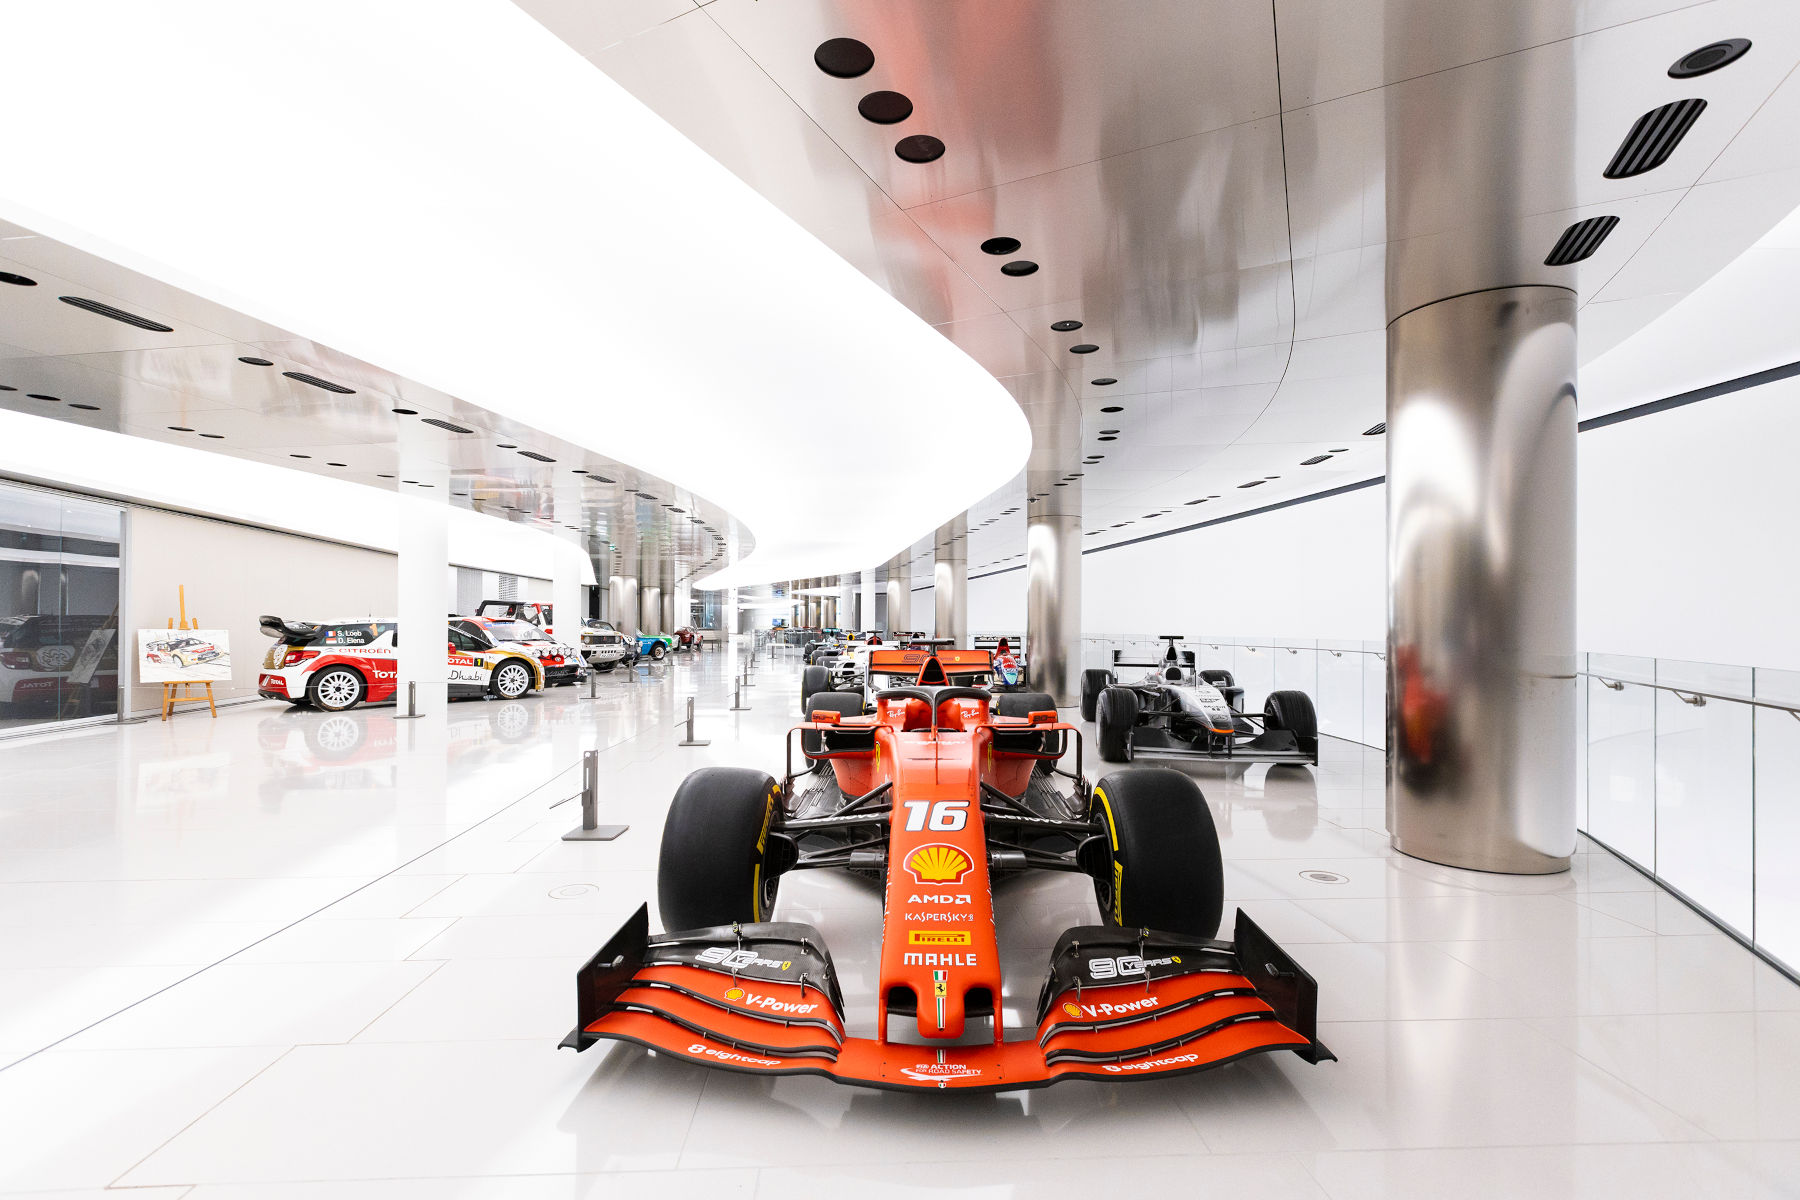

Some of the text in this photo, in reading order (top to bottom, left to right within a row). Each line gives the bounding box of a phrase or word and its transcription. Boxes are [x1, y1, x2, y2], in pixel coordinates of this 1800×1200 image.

[448, 657, 472, 665] OTAL
[448, 670, 483, 681] Dhabi
[903, 800, 970, 832] 16
[907, 894, 954, 904] AMD
[904, 911, 968, 923] KASPERSKY
[914, 933, 966, 943] PIRELLI
[903, 952, 977, 966] MAHLE
[1088, 955, 1146, 980] 90
[745, 993, 819, 1014] V-Power
[1080, 996, 1159, 1017] V-Power
[705, 1049, 782, 1066] eightcap
[1121, 1053, 1199, 1070] eightcap
